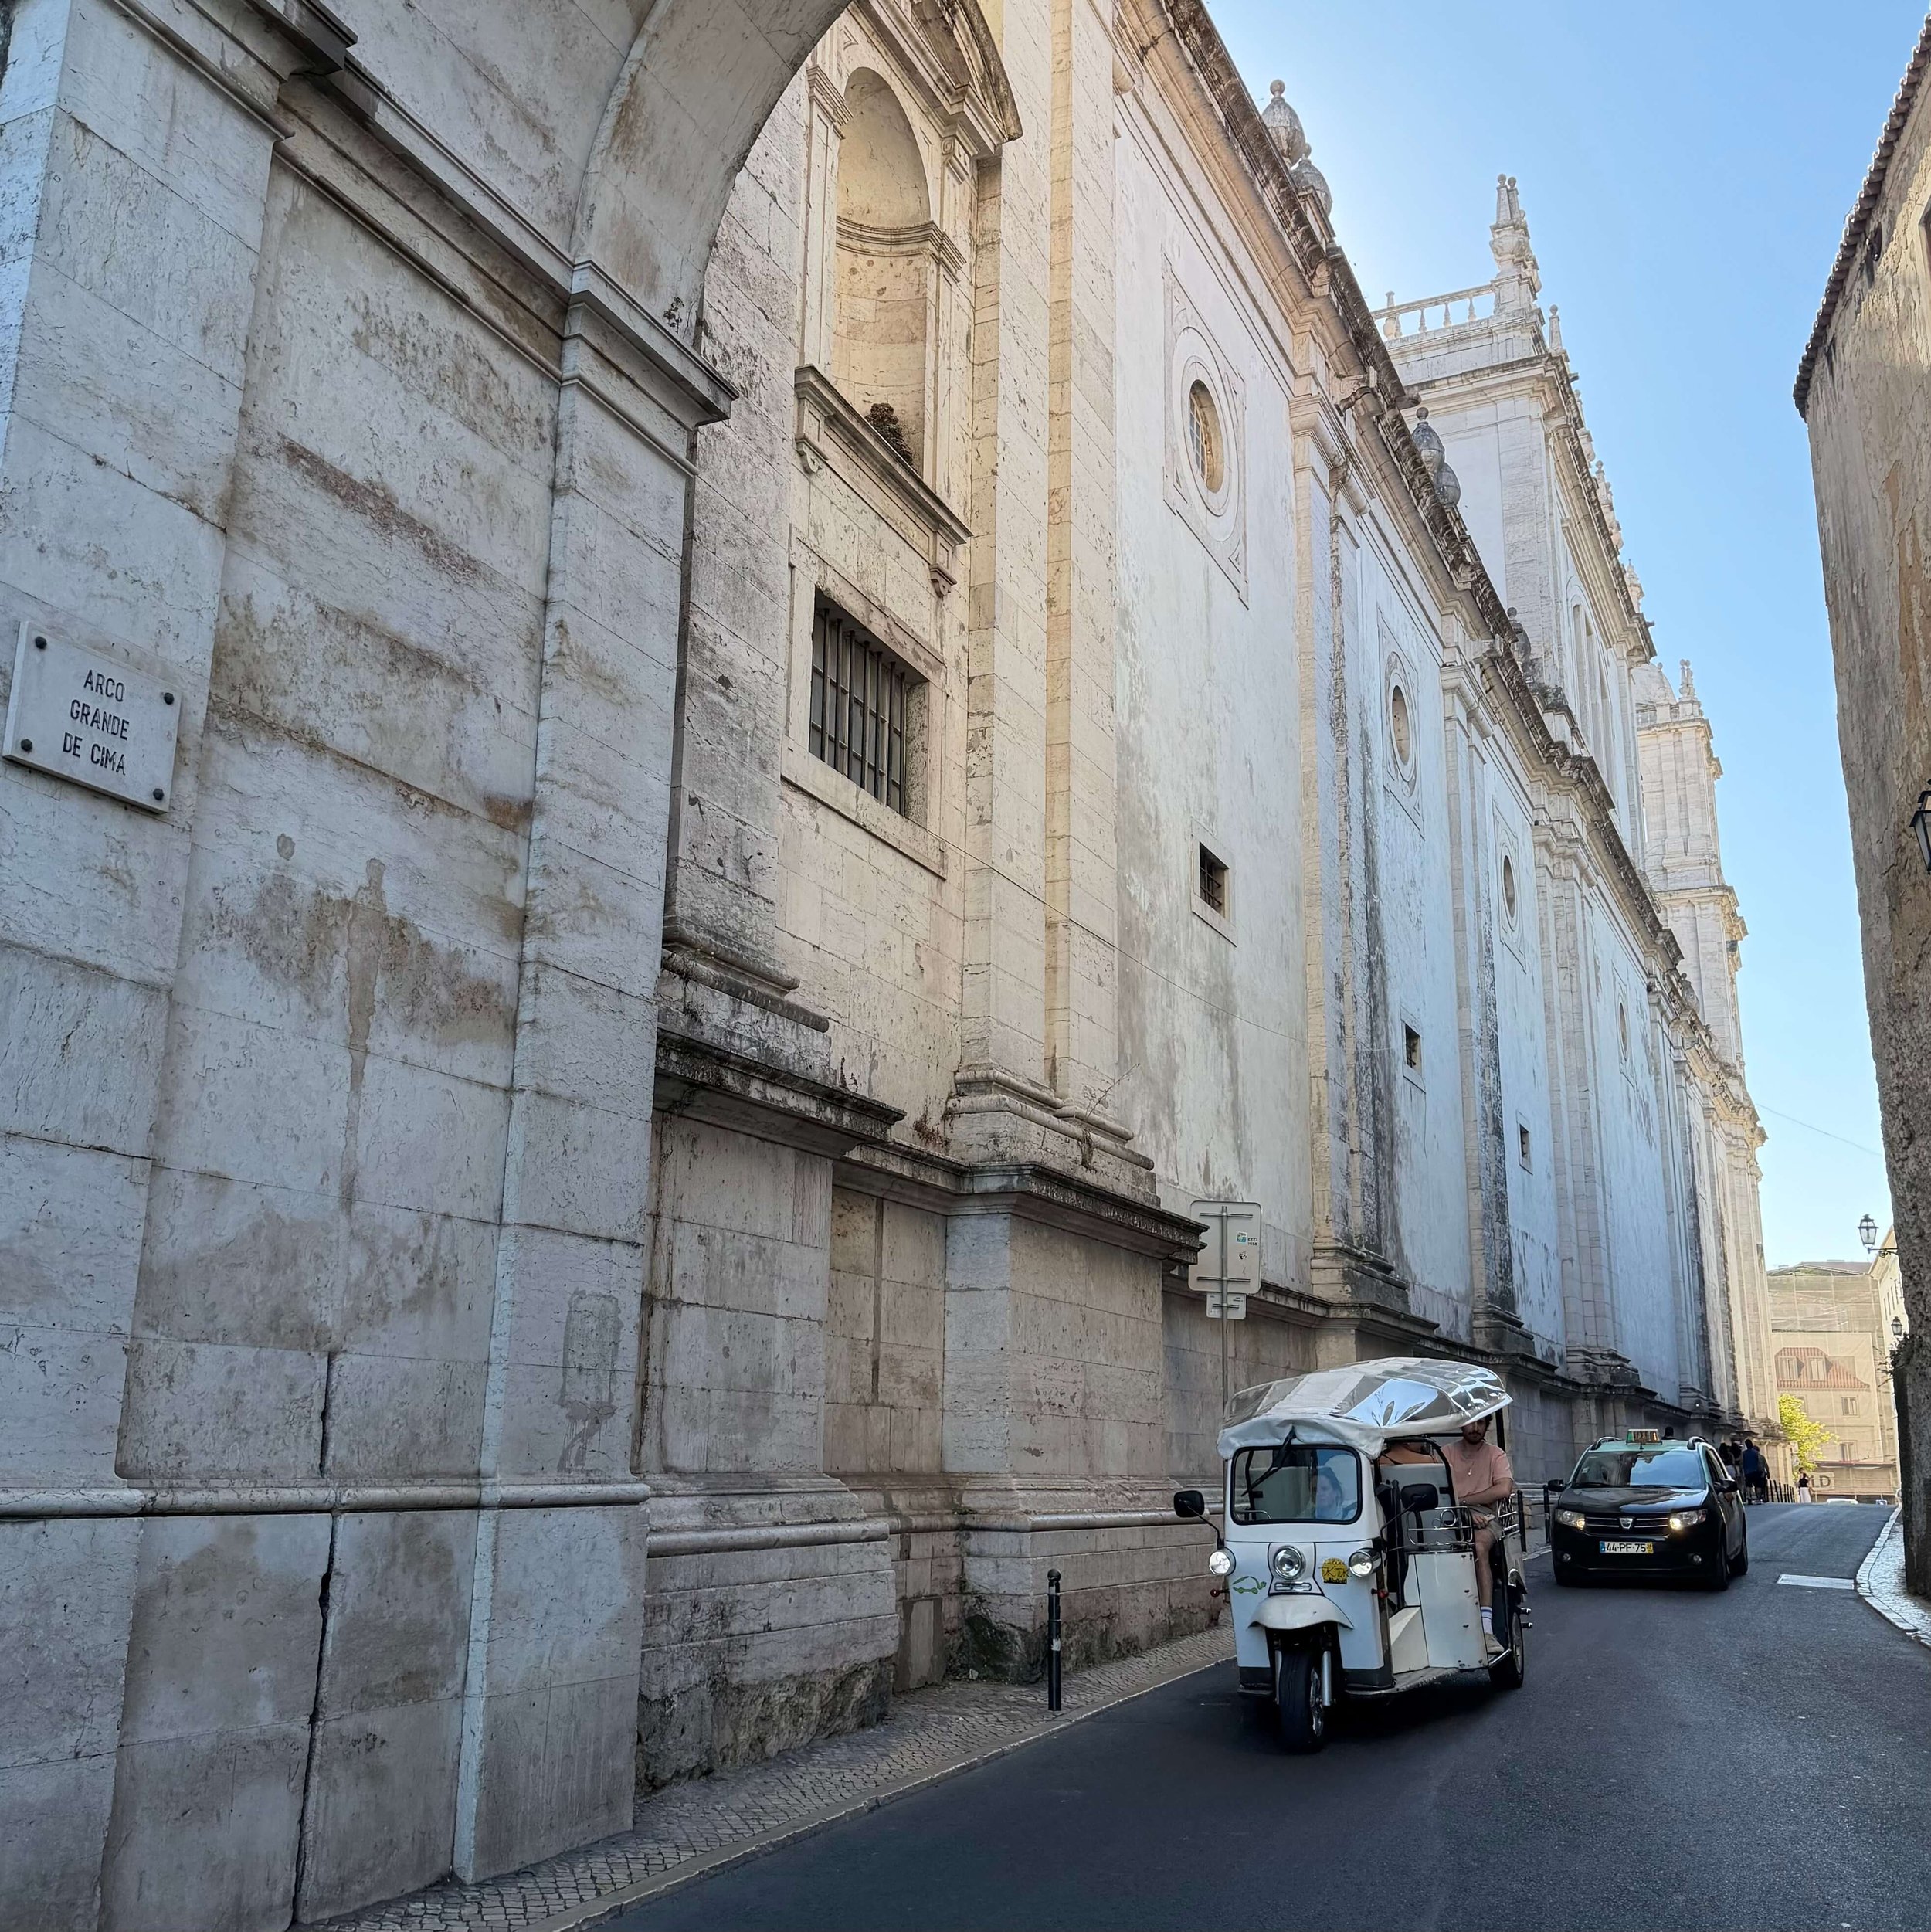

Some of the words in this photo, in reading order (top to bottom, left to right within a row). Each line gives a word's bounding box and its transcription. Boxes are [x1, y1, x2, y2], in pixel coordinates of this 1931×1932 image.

[83, 669, 125, 702] ARCO
[70, 699, 130, 740] GRANDE
[63, 732, 83, 759] DE
[90, 743, 126, 776] CIMA
[1607, 1543, 1646, 1552] 44-PF-75
